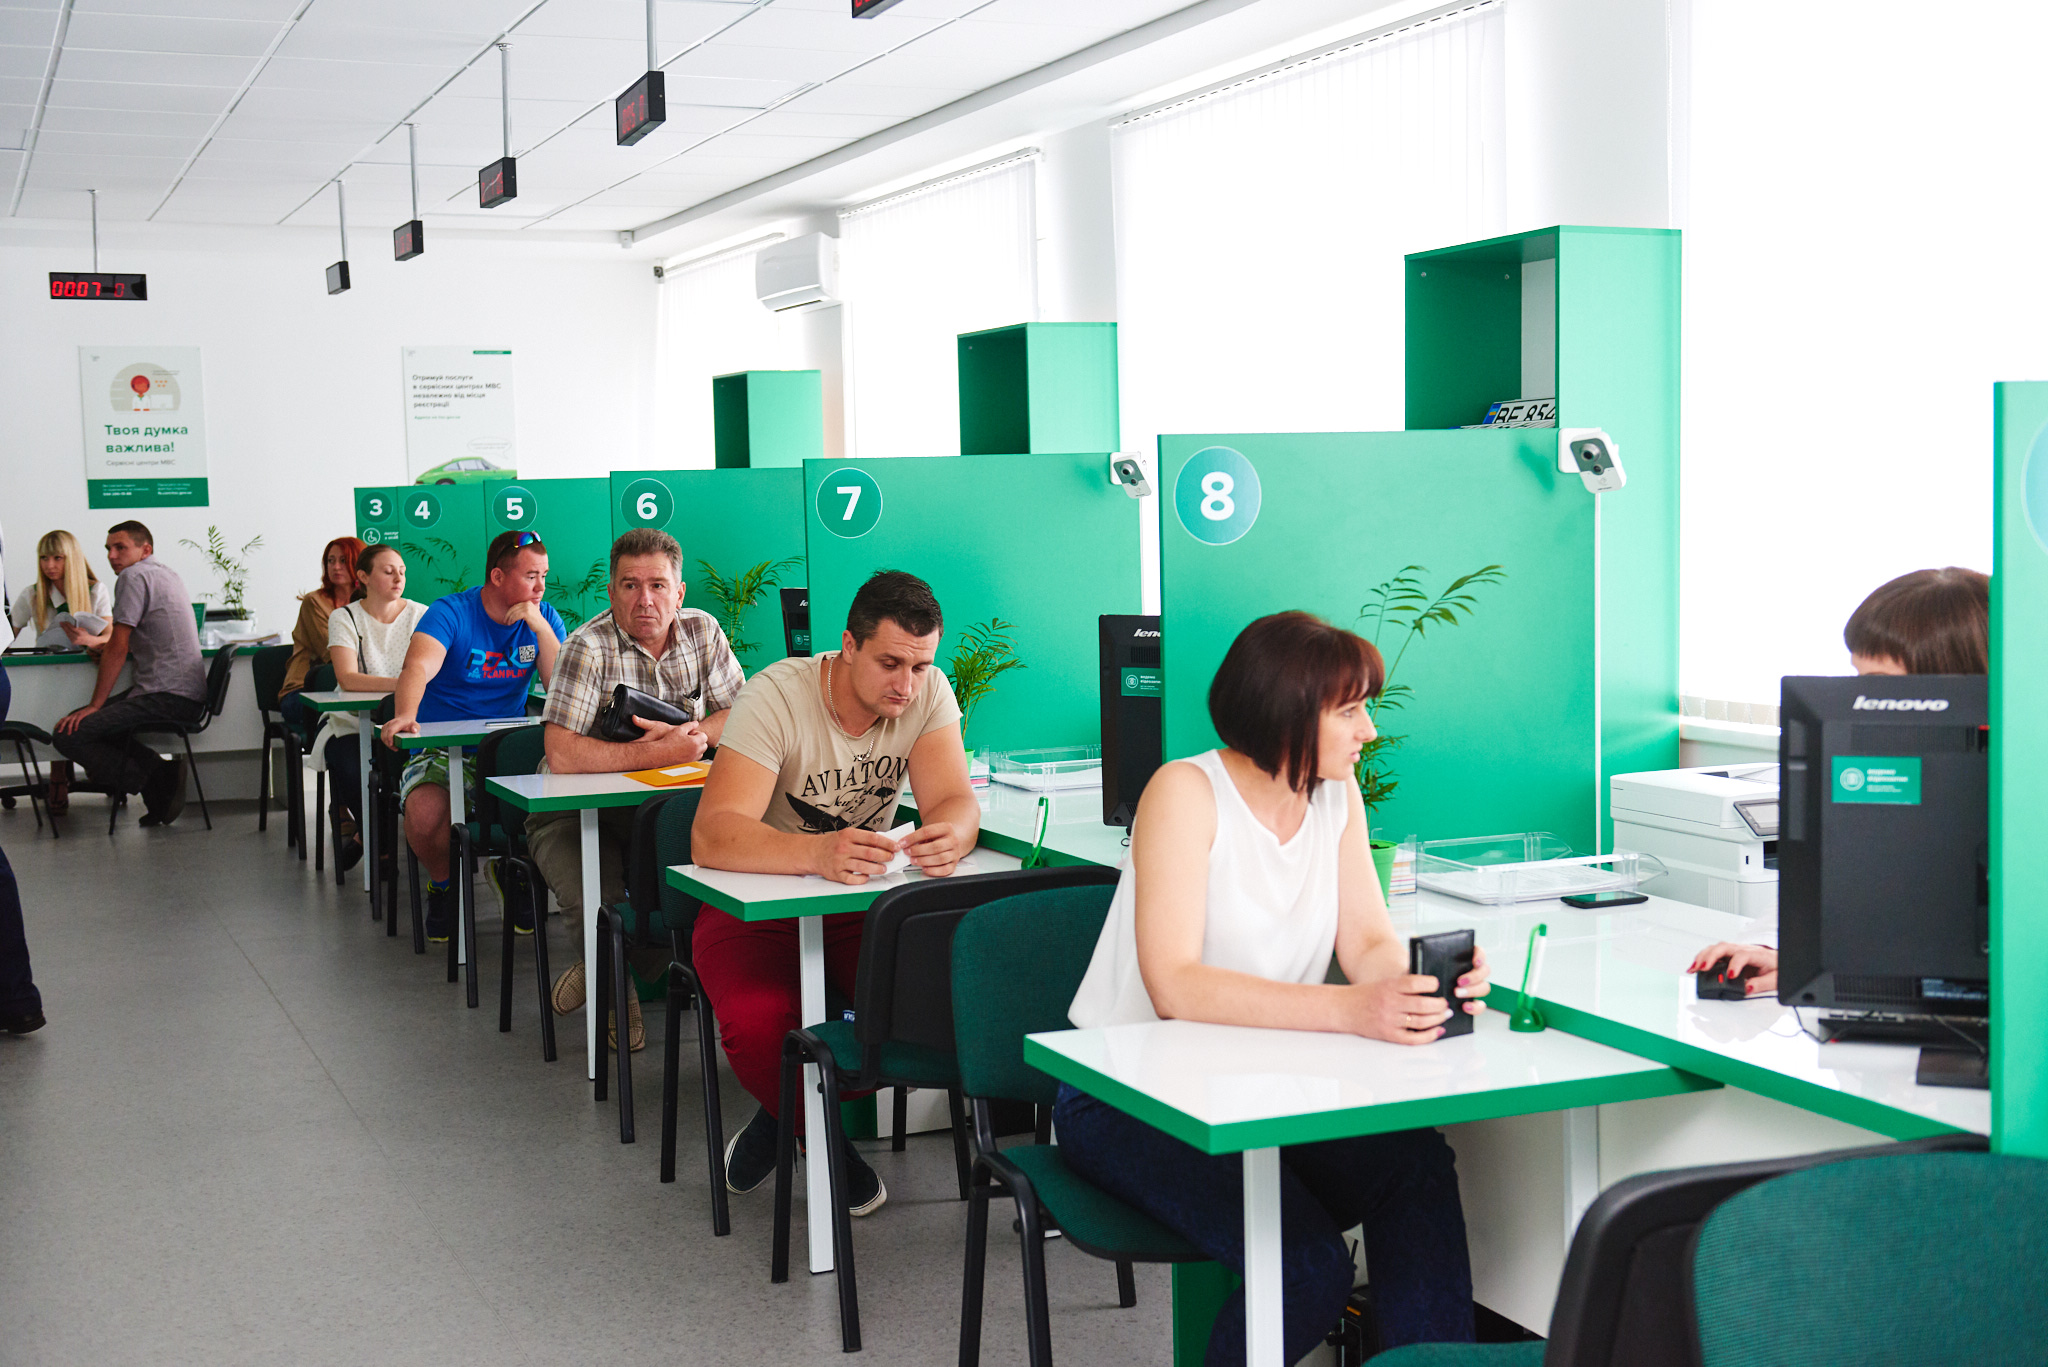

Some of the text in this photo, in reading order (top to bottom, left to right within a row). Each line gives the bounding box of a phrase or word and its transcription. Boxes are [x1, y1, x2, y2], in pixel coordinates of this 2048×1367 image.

[52, 280, 102, 297] 0007
[412, 374, 443, 382] Отримуй
[105, 424, 188, 438] Твоя думка
[106, 441, 175, 453] важлива!
[836, 485, 862, 521] 7
[1201, 471, 1235, 521] 8
[369, 499, 383, 516] 3
[414, 500, 431, 520] 4
[506, 497, 524, 520] 5
[636, 492, 658, 520] 6
[487, 669, 506, 679] CAN
[506, 668, 528, 679] PLAY
[1852, 695, 1949, 711] lenovo
